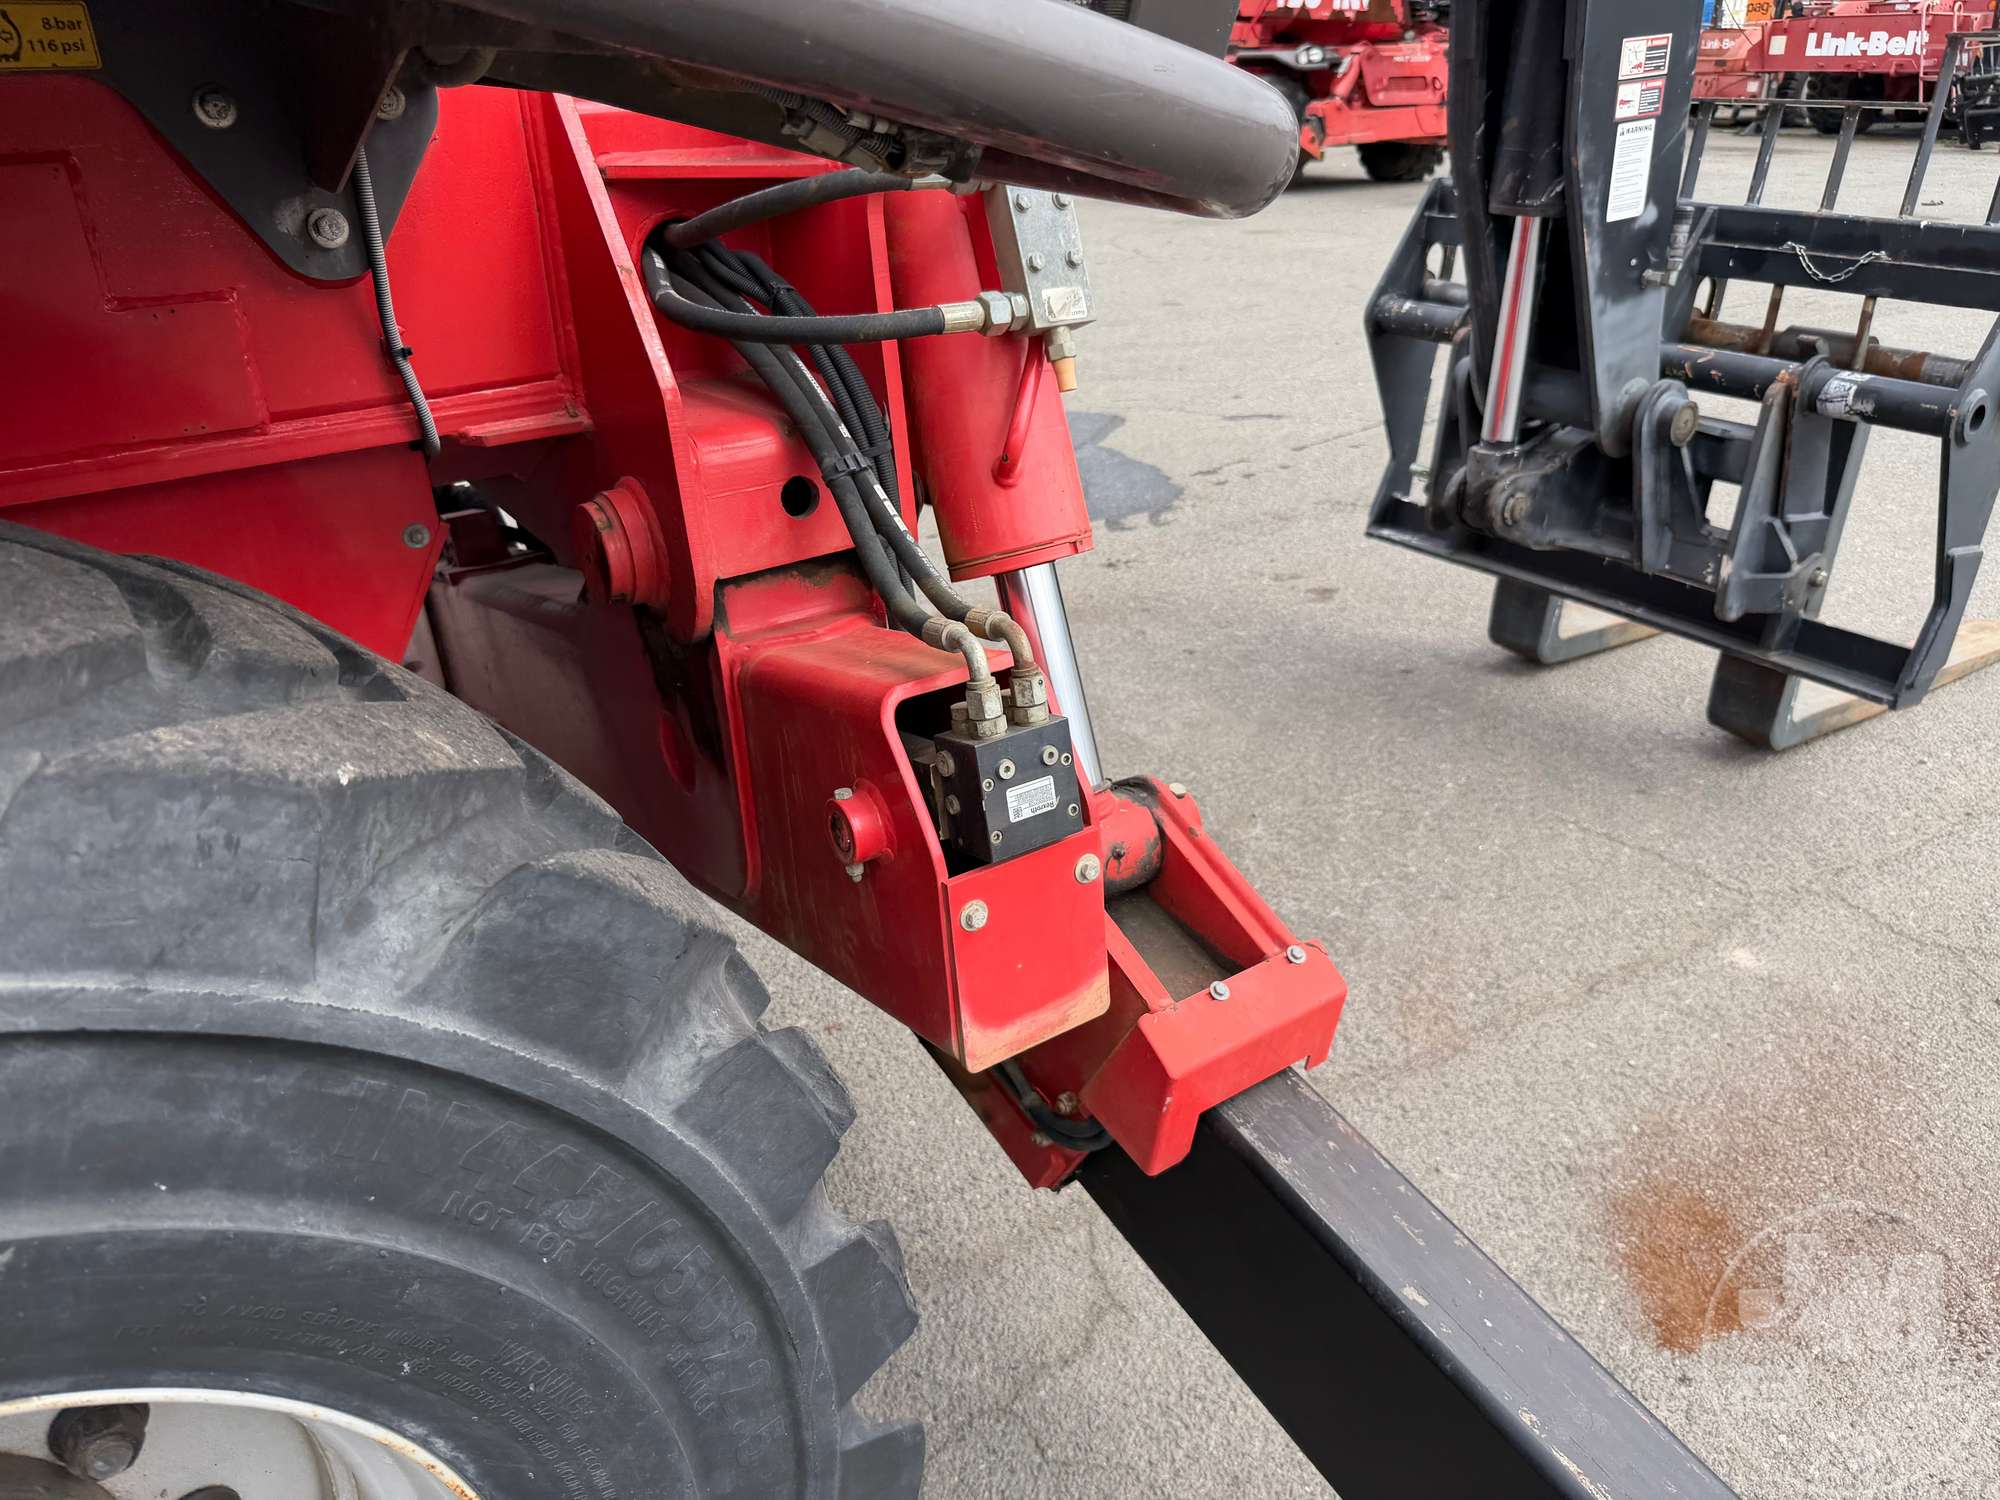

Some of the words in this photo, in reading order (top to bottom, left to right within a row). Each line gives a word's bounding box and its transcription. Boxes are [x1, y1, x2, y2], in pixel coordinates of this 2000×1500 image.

[42, 17, 53, 31] 8
[54, 16, 82, 31] bar
[28, 38, 58, 53] 116
[60, 38, 86, 55] psi
[1805, 29, 1930, 57] Link-Belt
[442, 1189, 513, 1234] NOT
[518, 1221, 576, 1263] FOR
[577, 1255, 673, 1339] HIGHWAY
